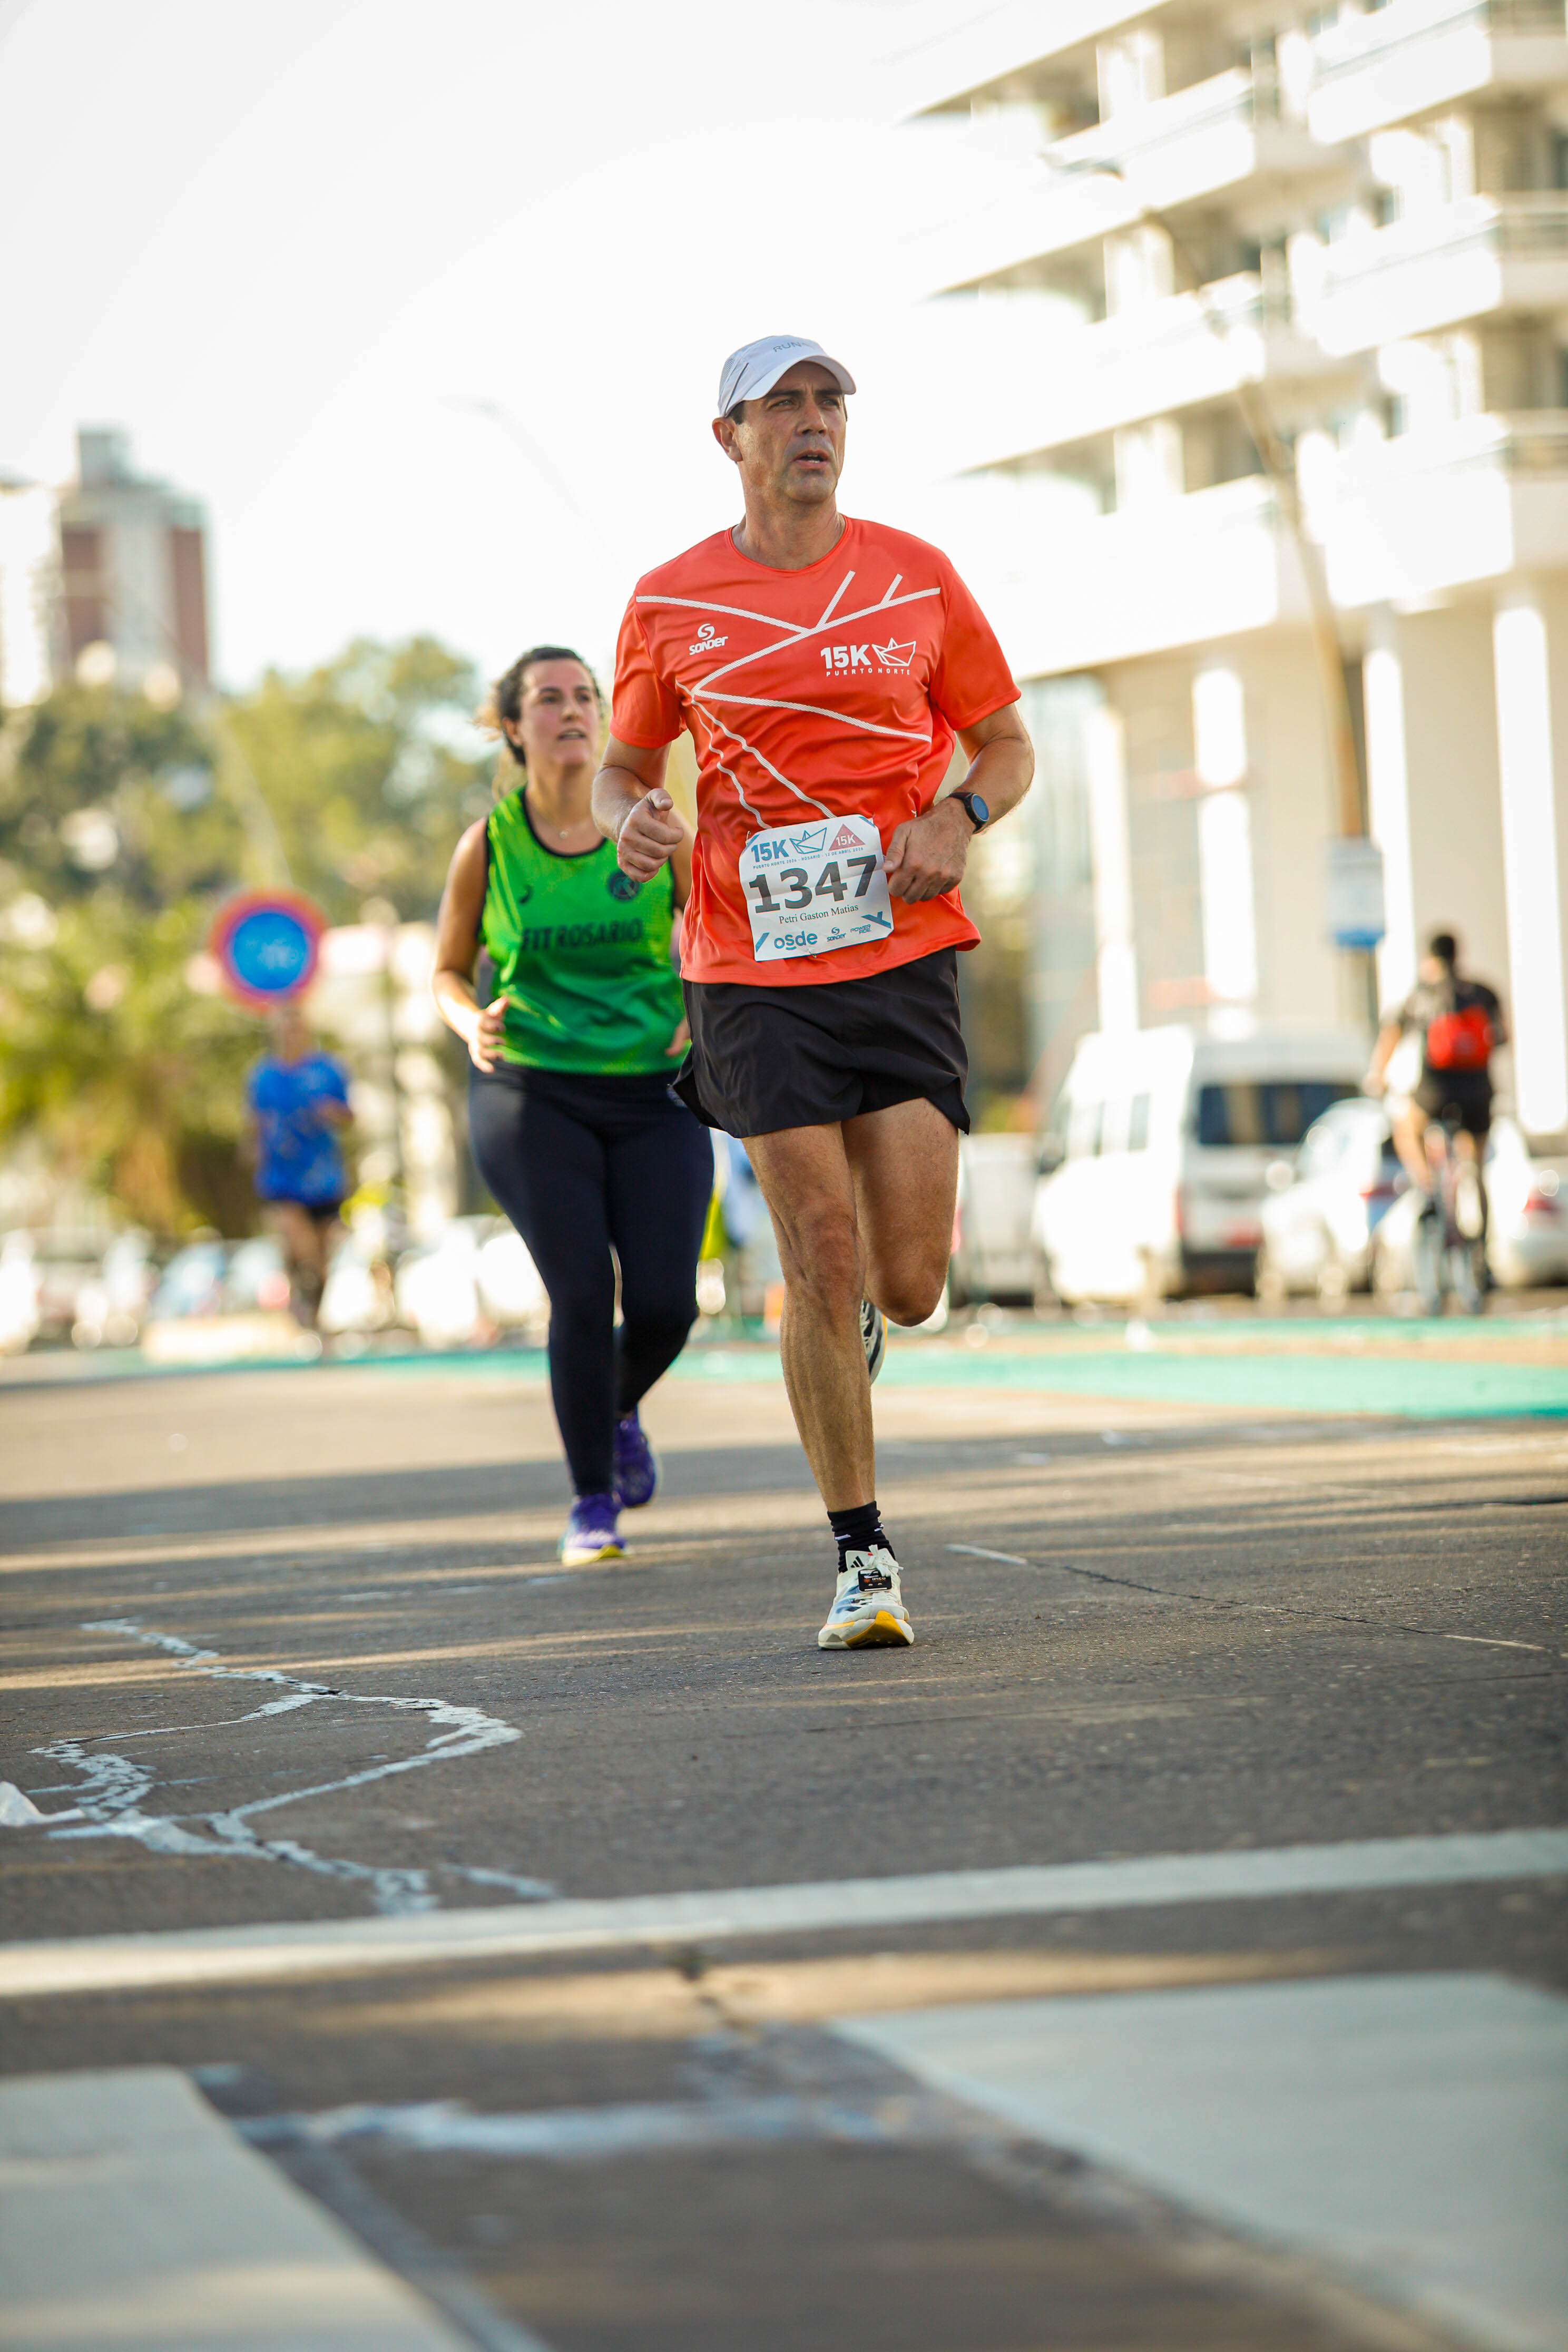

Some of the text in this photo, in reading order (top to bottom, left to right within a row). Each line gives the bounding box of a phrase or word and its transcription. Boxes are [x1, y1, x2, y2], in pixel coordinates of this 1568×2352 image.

[820, 644, 871, 669] 15K
[836, 834, 856, 846] 15K
[751, 839, 789, 863] 15K
[749, 855, 877, 913] 1347
[779, 905, 859, 924] Petri Gaston Matias
[774, 930, 818, 949] osde
